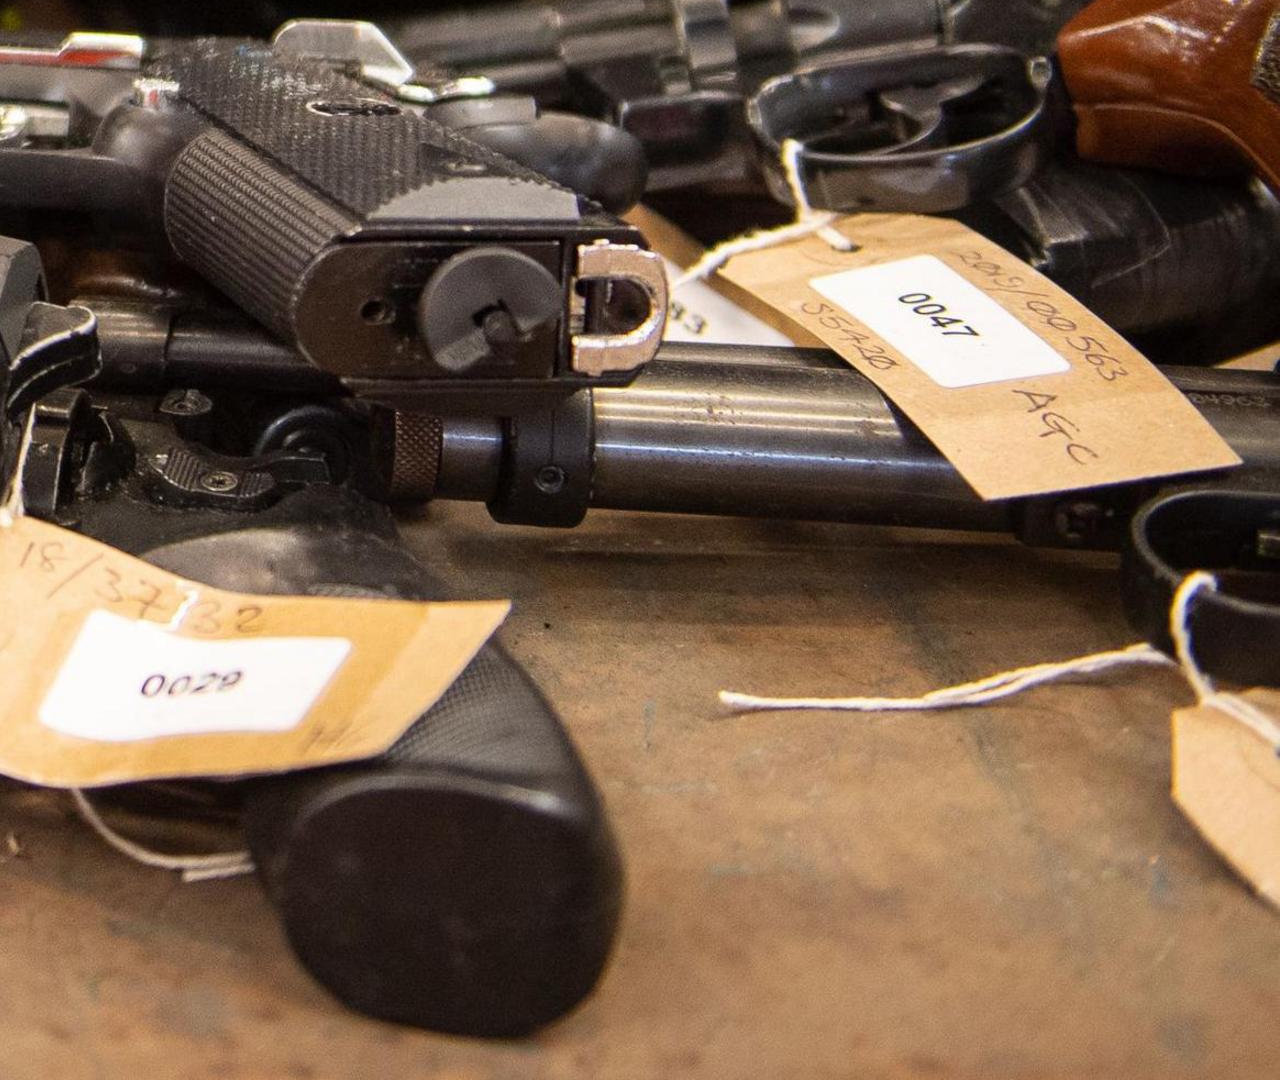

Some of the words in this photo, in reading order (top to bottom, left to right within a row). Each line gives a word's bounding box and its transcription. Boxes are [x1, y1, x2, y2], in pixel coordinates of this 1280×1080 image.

[898, 292, 981, 339] 0047
[1012, 387, 1100, 467] AGC
[140, 669, 245, 697] 0029
